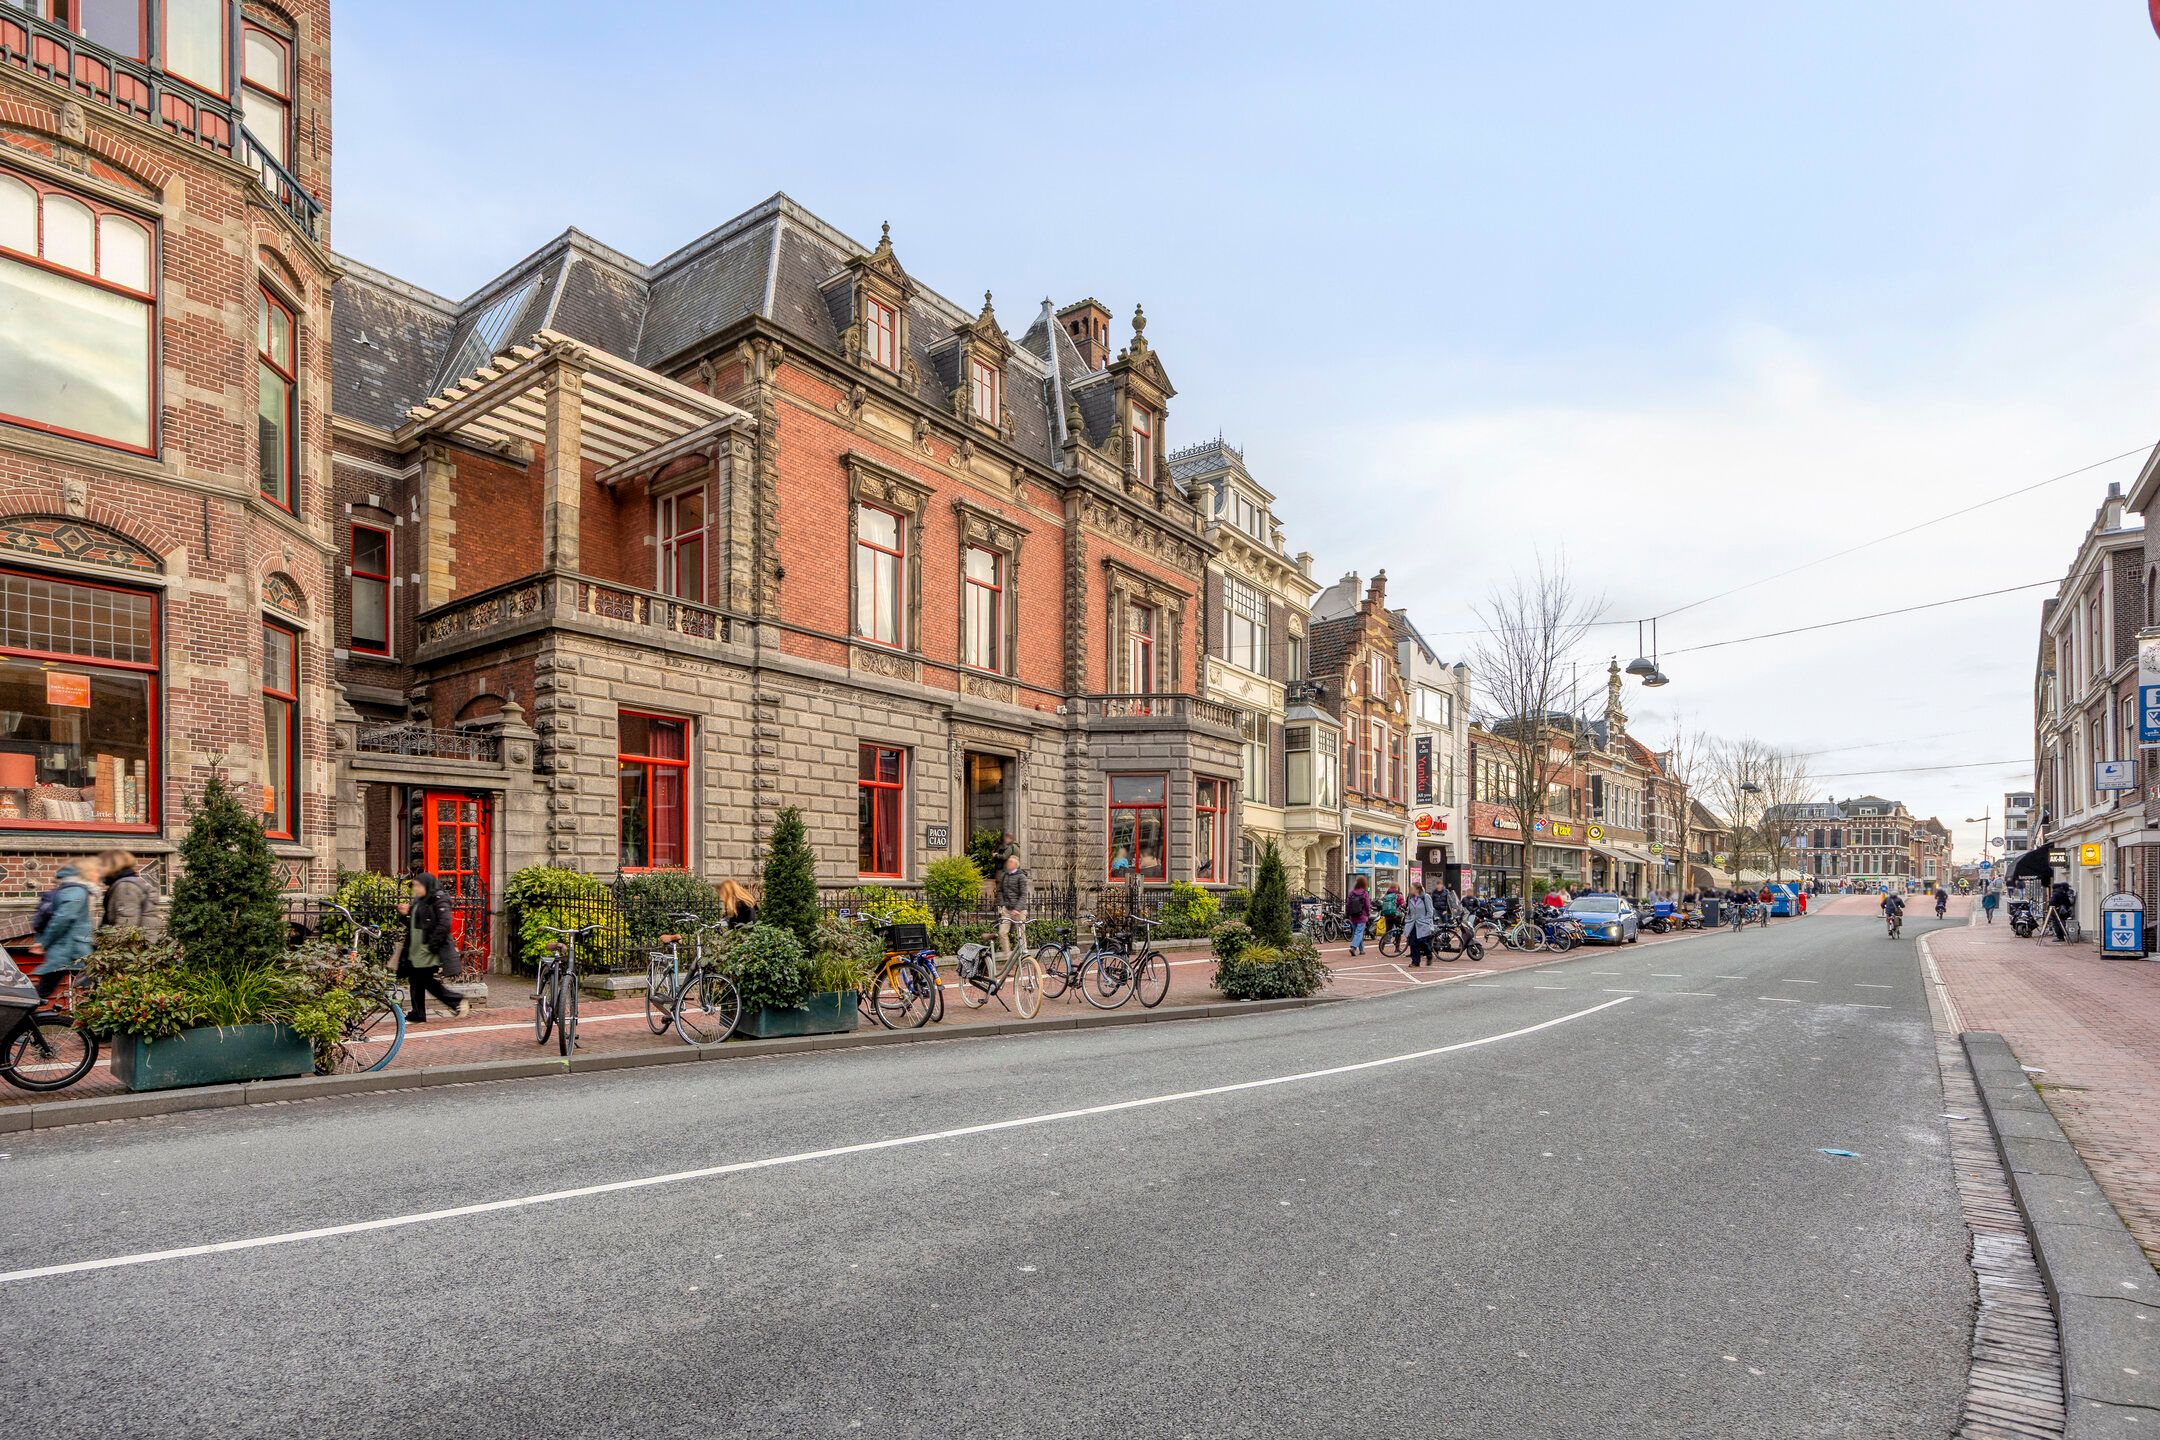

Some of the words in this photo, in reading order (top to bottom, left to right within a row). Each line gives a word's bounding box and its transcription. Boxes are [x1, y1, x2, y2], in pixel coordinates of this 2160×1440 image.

[1418, 755, 1428, 791] Yuniku
[91, 810, 112, 818] Little
[930, 828, 947, 837] PACO
[929, 836, 947, 845] CIAO
